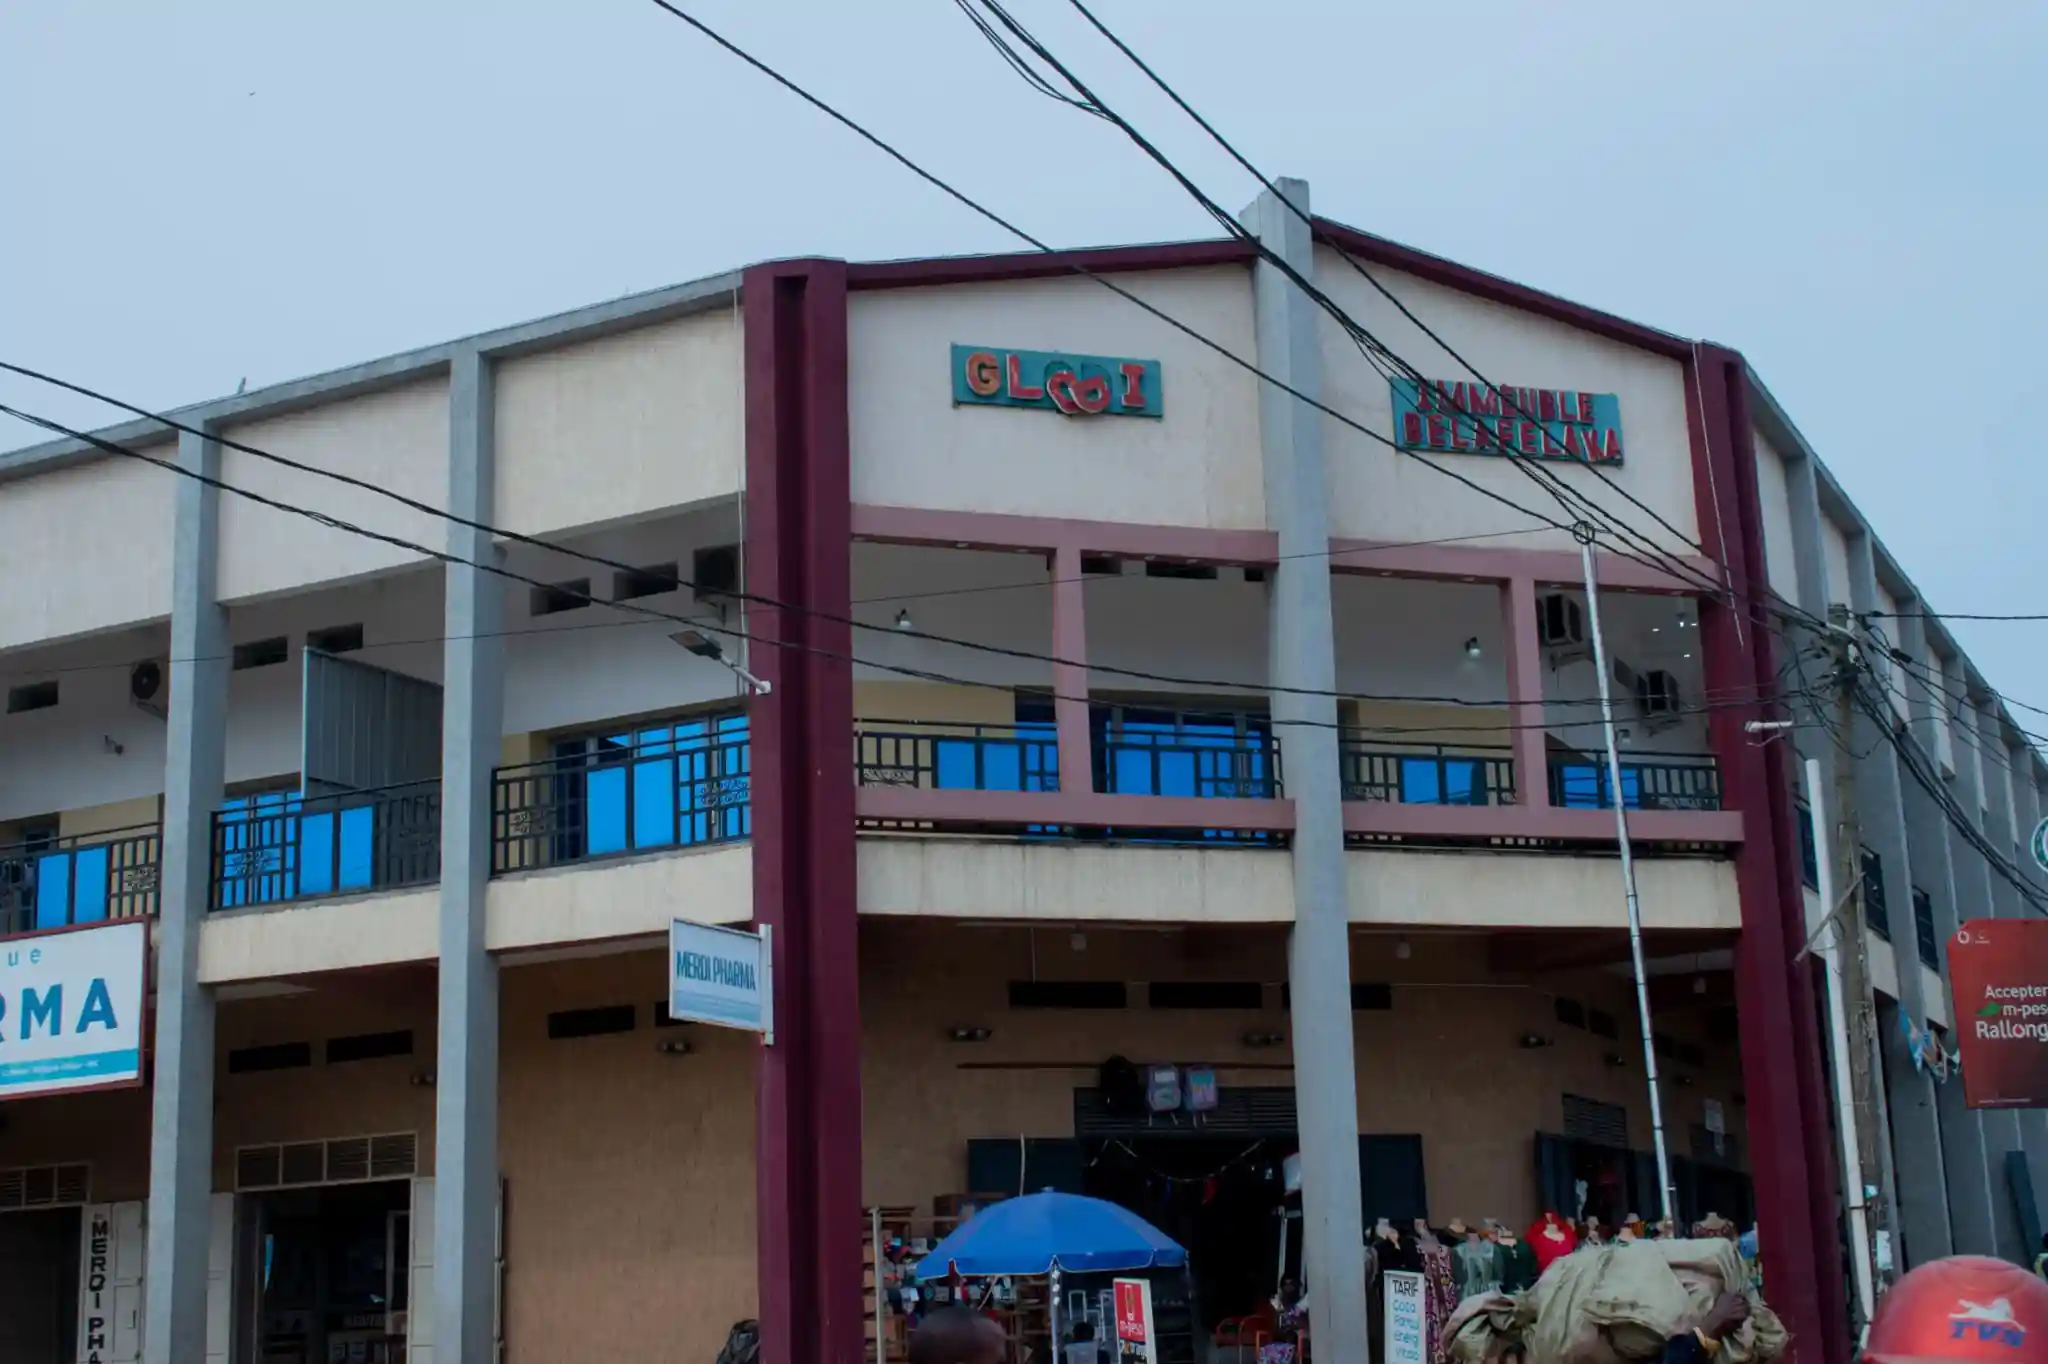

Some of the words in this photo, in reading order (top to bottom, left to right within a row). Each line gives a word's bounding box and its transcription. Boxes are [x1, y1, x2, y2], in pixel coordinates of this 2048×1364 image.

[1418, 379, 1595, 423] IMMEUBLE
[676, 950, 711, 981] MERDI
[713, 956, 756, 991] PHARMA
[0, 978, 118, 1042] MA
[1392, 1279, 1419, 1297] TARIF
